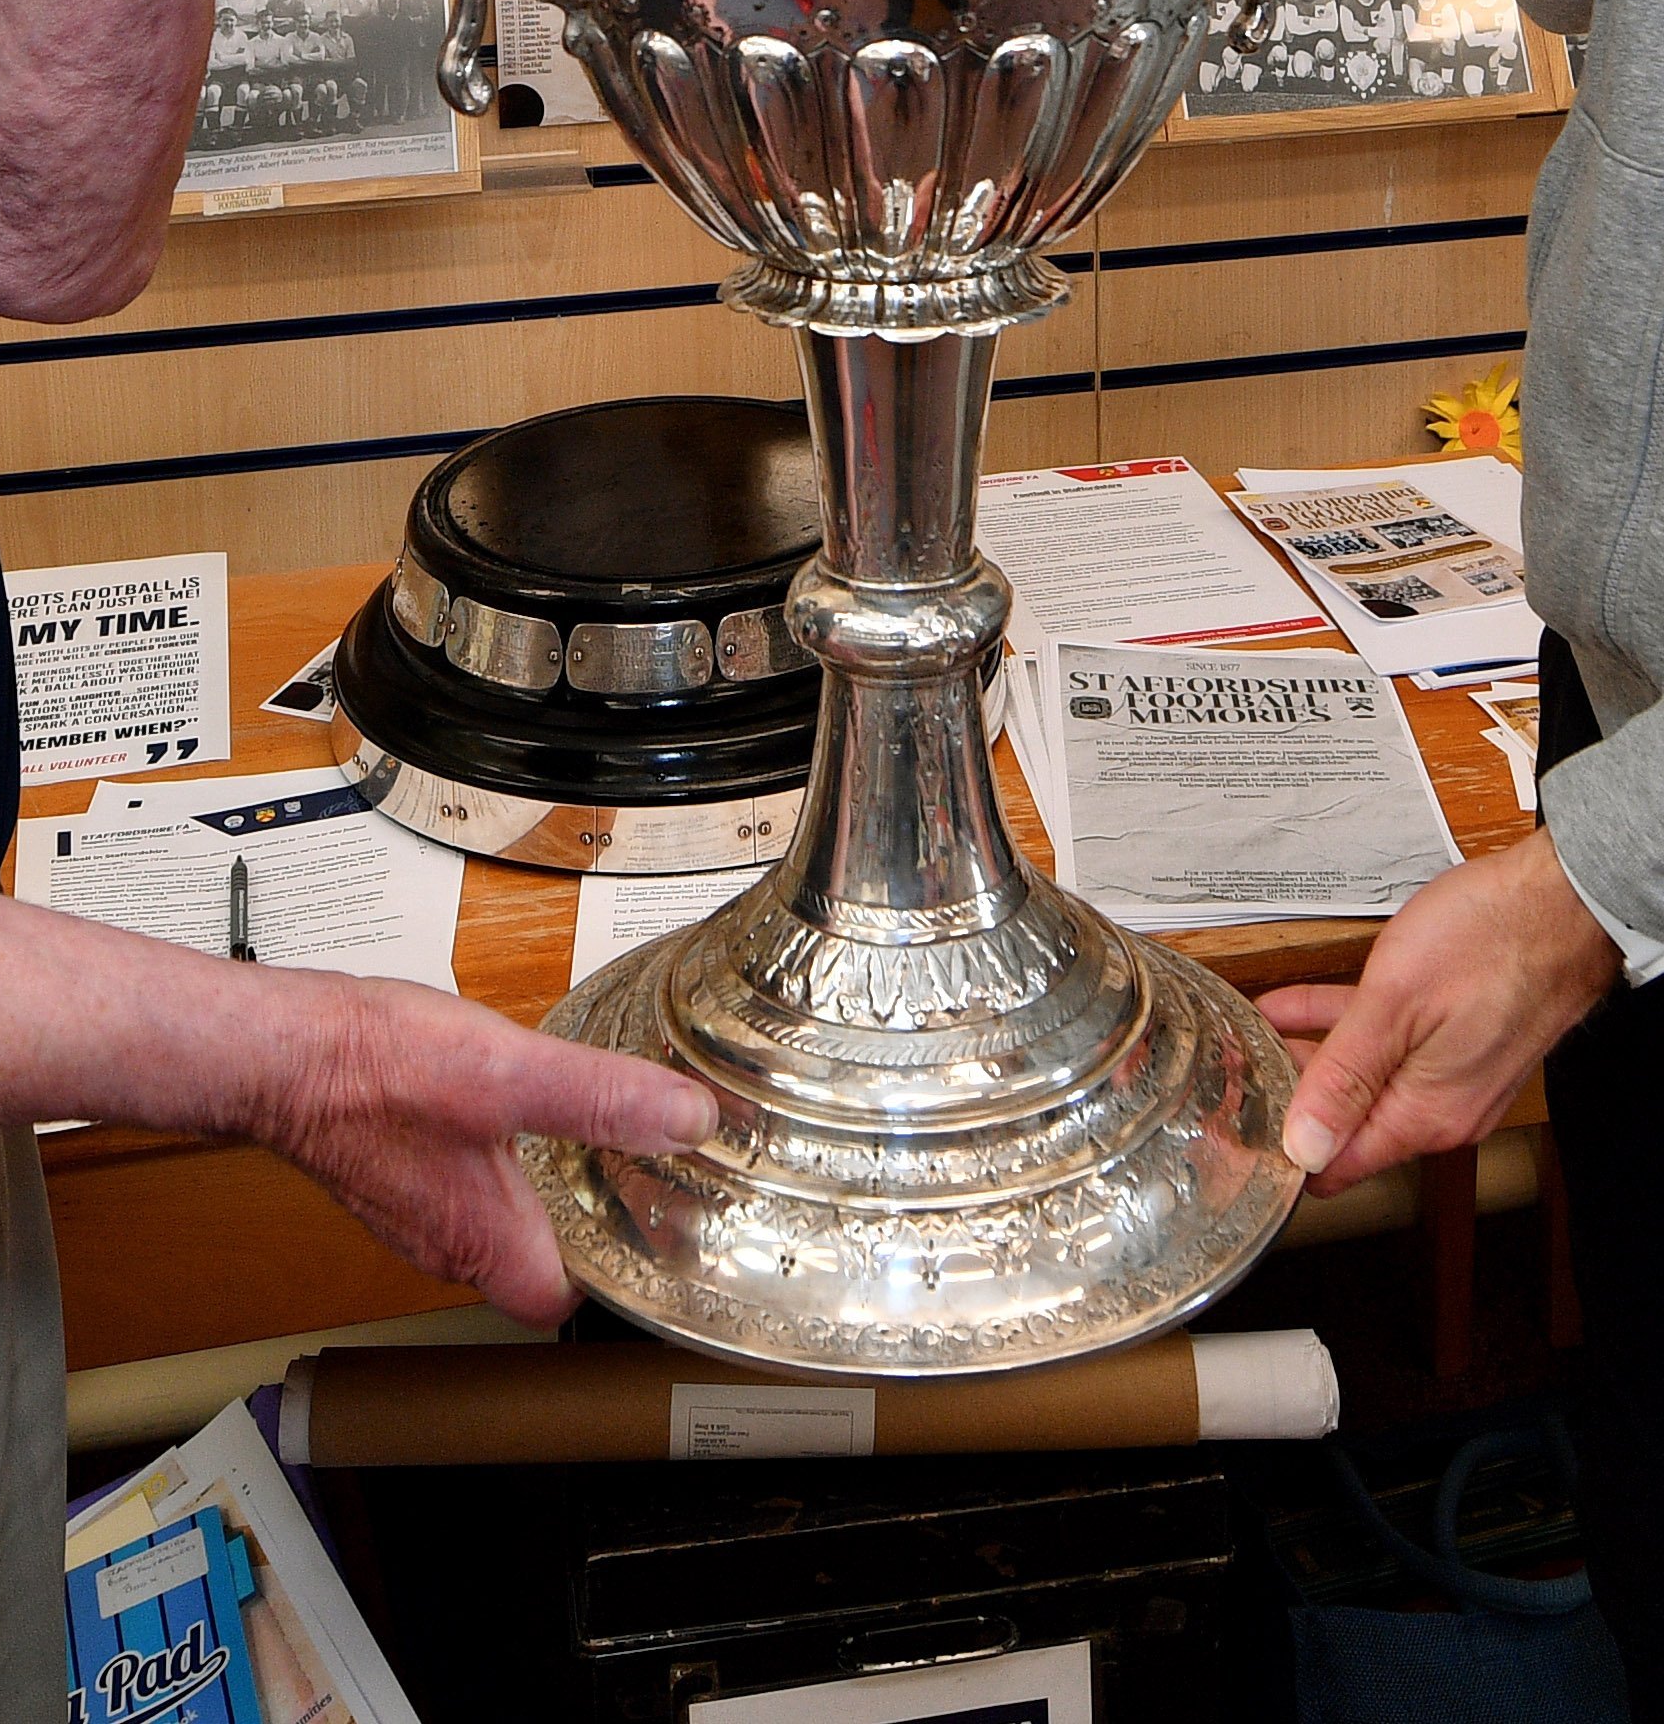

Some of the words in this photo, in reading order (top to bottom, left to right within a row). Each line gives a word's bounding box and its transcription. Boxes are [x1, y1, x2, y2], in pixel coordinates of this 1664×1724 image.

[1248, 487, 1418, 516] STAFFORDSHIRE
[1280, 500, 1398, 523] FOOTBALL
[1294, 506, 1413, 530] MEMORIES
[71, 580, 175, 602] FOOTBALL
[182, 576, 200, 588] IS
[45, 606, 50, 615] I
[57, 600, 91, 614] CAN
[97, 596, 136, 610] JUST
[143, 592, 163, 603] BE
[170, 588, 200, 601] ME!
[18, 618, 82, 647] MY
[96, 606, 200, 637] TIME.
[104, 645, 154, 656] CHERISHED
[158, 640, 197, 649] FOREVER
[109, 638, 145, 649] PEOPLE
[149, 635, 176, 644] FROM
[180, 632, 199, 640] OUR
[1186, 662, 1218, 671] SINCE
[1220, 663, 1241, 672] 1877
[1069, 672, 1379, 694] STAFFORDSHIRE
[1127, 692, 1328, 708] FOOTBALL
[24, 720, 67, 732] SPARK
[71, 718, 80, 726] A
[1130, 708, 1333, 724] MEMORIES
[115, 718, 199, 739] WHEN?"
[50, 753, 128, 771] VOLUNTEER
[96, 1620, 212, 1717] Pad
